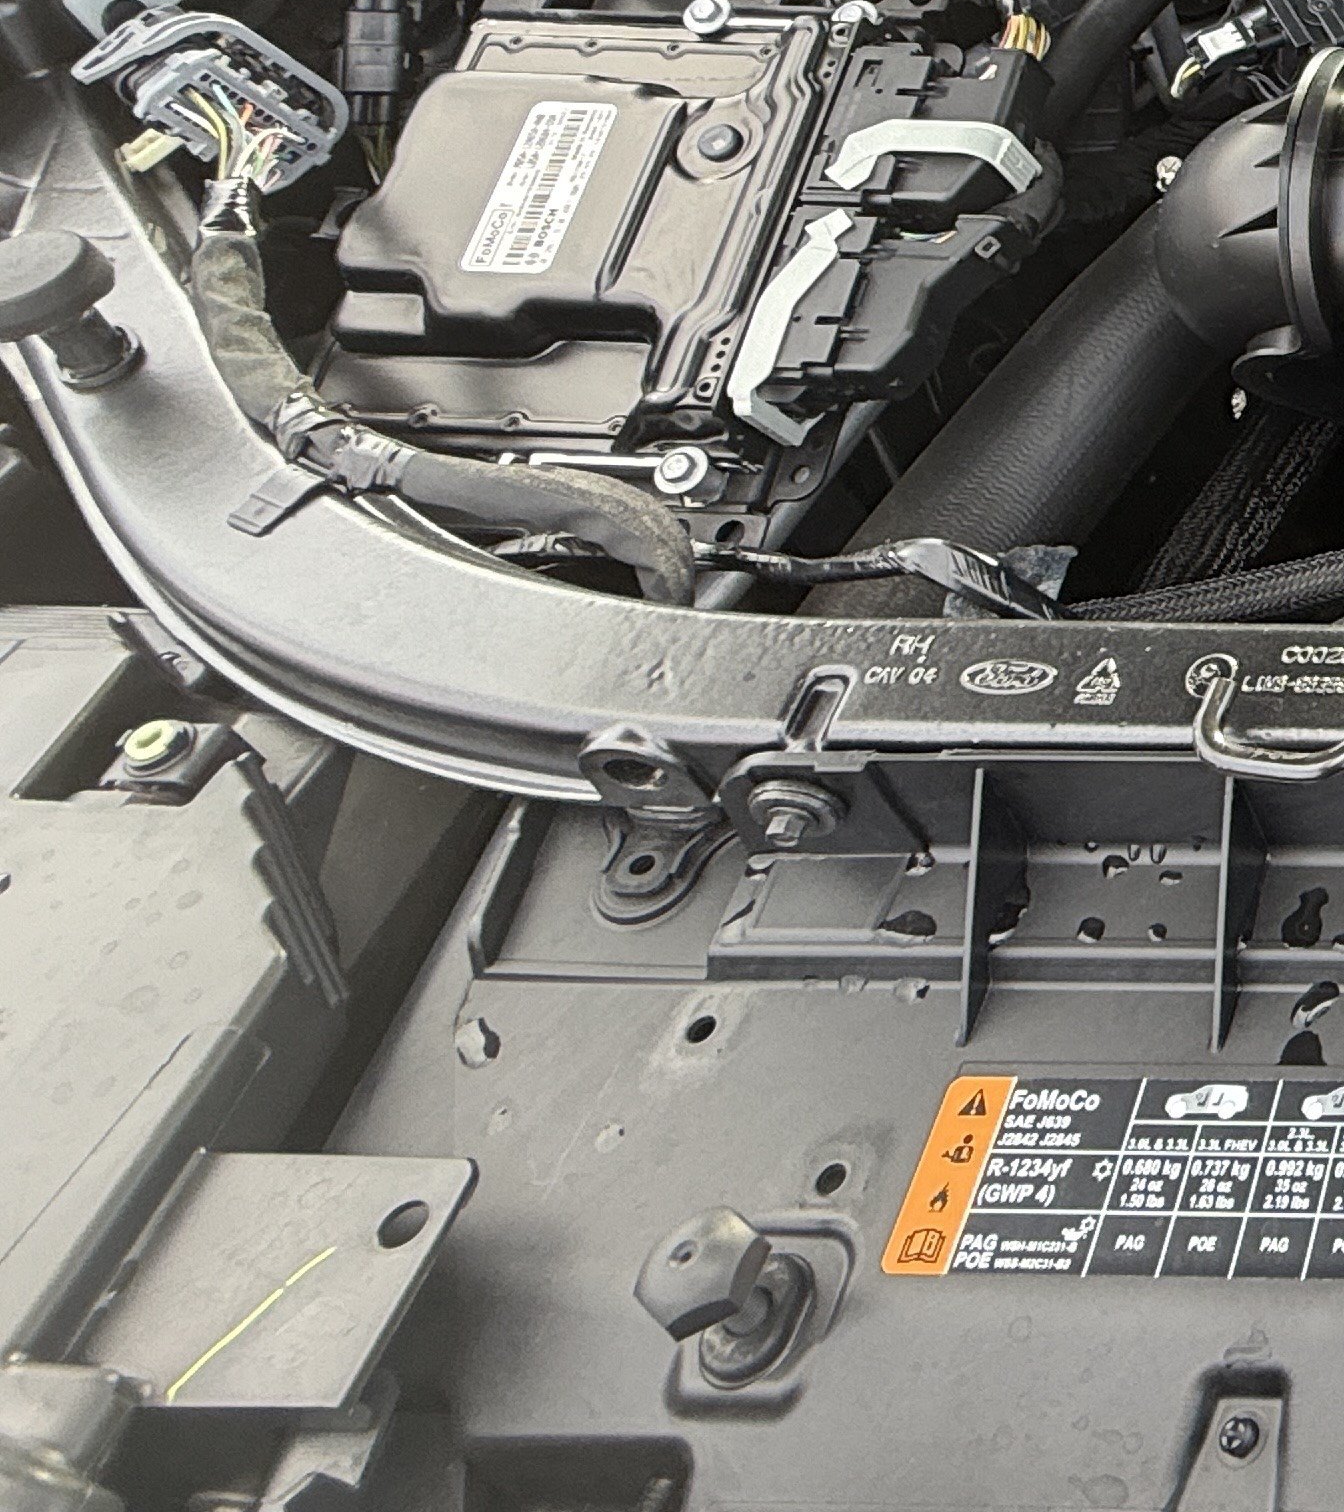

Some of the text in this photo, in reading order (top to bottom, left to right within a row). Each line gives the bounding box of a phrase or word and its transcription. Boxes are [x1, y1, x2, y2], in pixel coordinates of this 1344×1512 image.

[474, 211, 508, 264] FoMoCo
[533, 208, 559, 248] BOSCH
[889, 634, 935, 655] RH
[1008, 1088, 1101, 1112] FoMoCo
[1003, 1114, 1037, 1129] SAE
[1223, 1138, 1259, 1152] FHEV
[986, 1158, 1073, 1182] R-1234yf
[1122, 1158, 1182, 1180] 0.680 kg
[1191, 1159, 1252, 1182] 0.737 kg
[1265, 1159, 1325, 1181] 0.992 kg
[976, 1182, 1056, 1207] (GWP 4)
[1274, 1178, 1308, 1193] 35 oz
[959, 1233, 998, 1251] PAG
[1114, 1234, 1145, 1250] PAG
[1187, 1236, 1218, 1252] POE
[1258, 1237, 1290, 1253] PAG
[952, 1251, 994, 1268] POE
